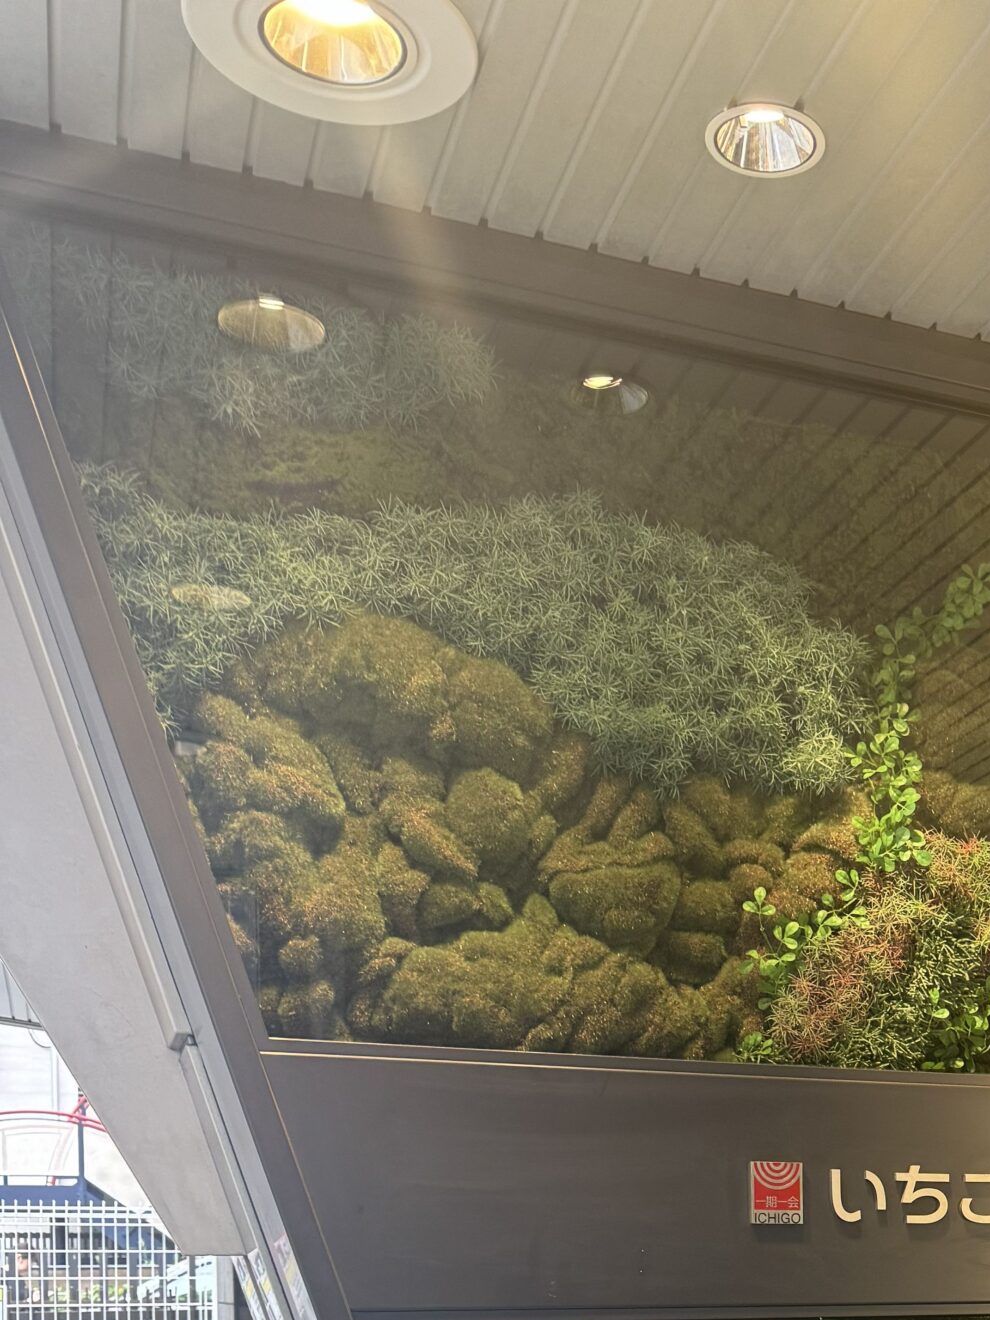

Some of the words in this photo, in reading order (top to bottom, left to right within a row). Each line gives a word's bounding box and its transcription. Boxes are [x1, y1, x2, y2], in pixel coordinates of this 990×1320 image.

[755, 1195, 799, 1209] 一期一会
[754, 1212, 801, 1224] ICHIGO
